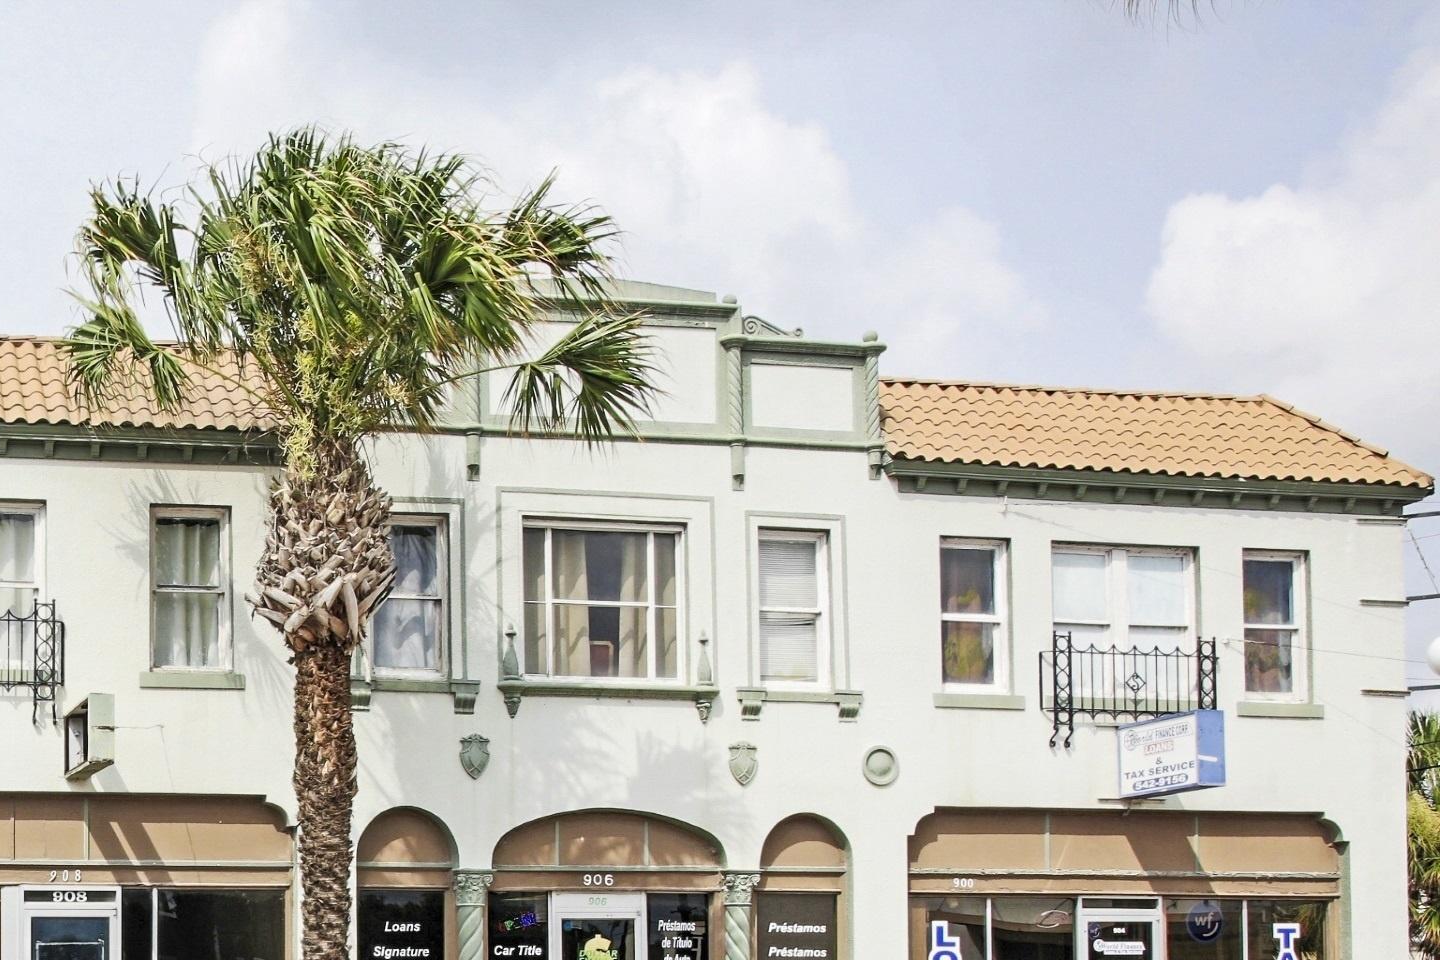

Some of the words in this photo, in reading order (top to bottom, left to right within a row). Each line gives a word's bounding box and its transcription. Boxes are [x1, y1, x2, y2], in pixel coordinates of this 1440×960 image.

[1155, 757, 1162, 765] &
[1124, 769, 1145, 780] TAX
[1149, 761, 1195, 776] SERVICE
[583, 874, 614, 886] 906
[953, 878, 974, 888] 900
[52, 891, 88, 902] 908
[588, 897, 608, 906] 906
[658, 920, 696, 931] Préstamos
[1195, 912, 1214, 929] wf
[384, 921, 421, 932] Loans
[768, 922, 827, 933] Préstamos
[661, 937, 671, 948] de
[373, 946, 430, 959] Signature
[494, 945, 514, 955] Car
[518, 945, 542, 956] Title
[768, 946, 828, 957] Préstamos
